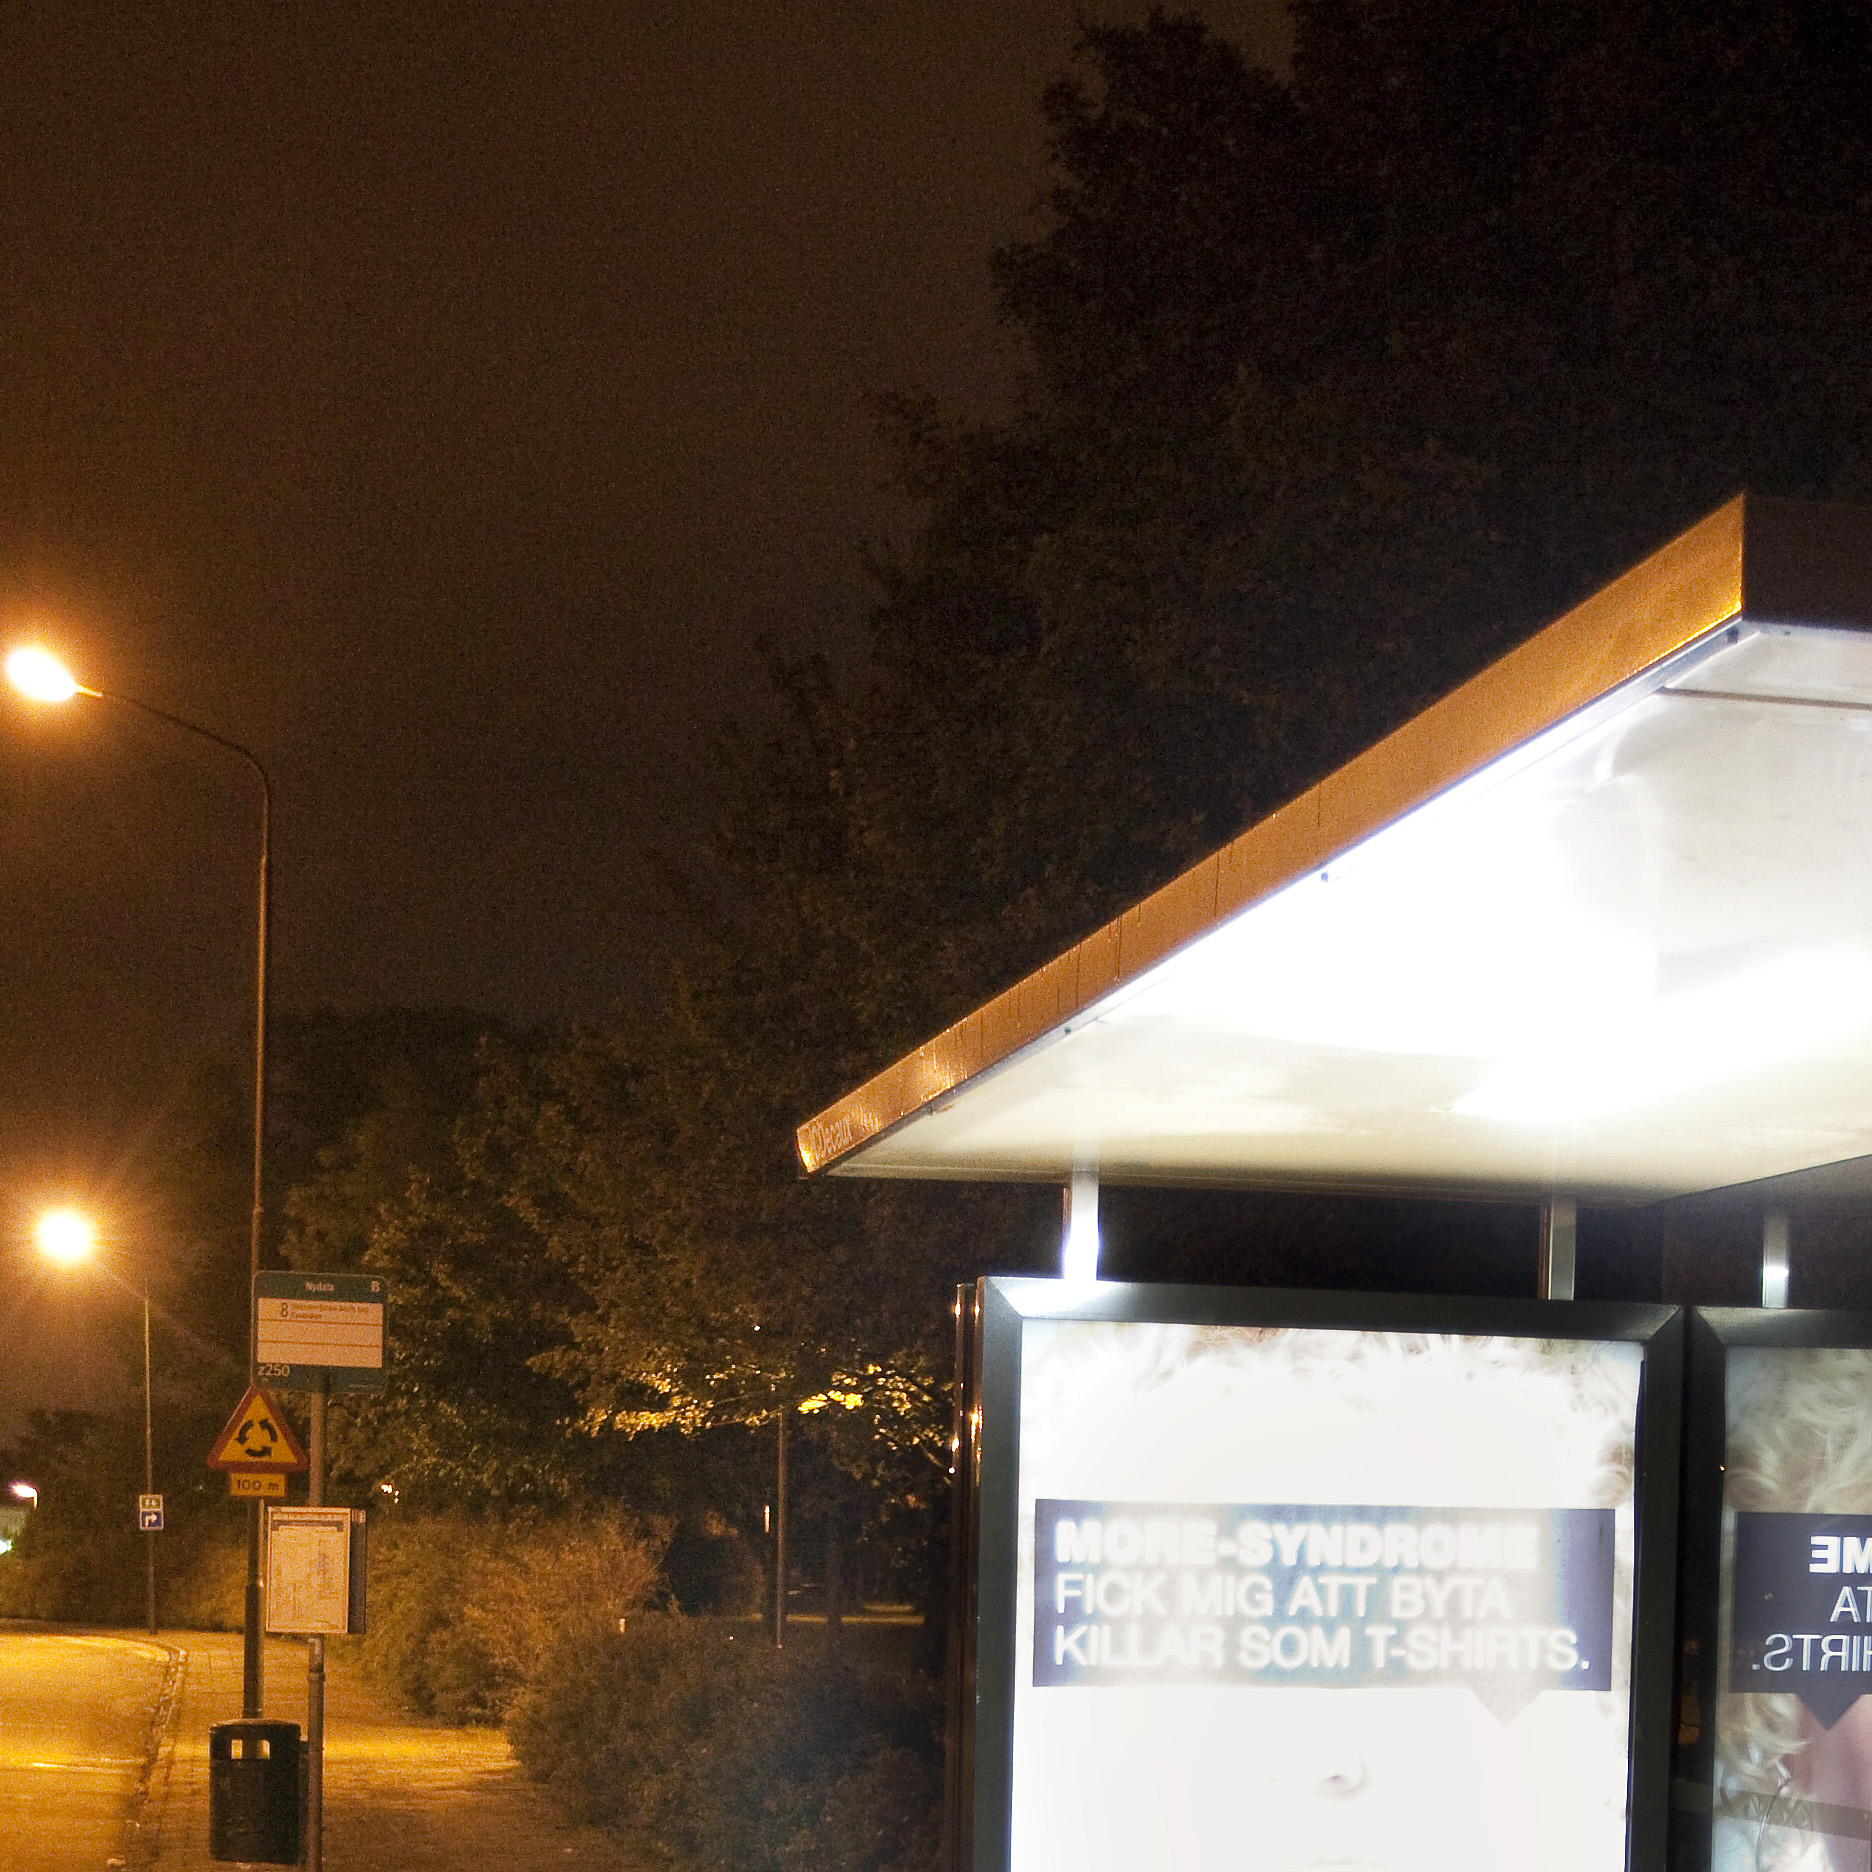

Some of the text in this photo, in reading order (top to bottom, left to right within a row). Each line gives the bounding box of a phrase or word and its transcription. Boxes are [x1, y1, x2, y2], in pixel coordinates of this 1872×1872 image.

[237, 1479, 263, 1491] 100
[1054, 1520, 1539, 1569] MORE-SYNDROME
[1054, 1573, 1513, 1621] FICK MIG ATT BYTA
[1054, 1625, 1589, 1671] KILLAR SOM T-SHIRTS.
